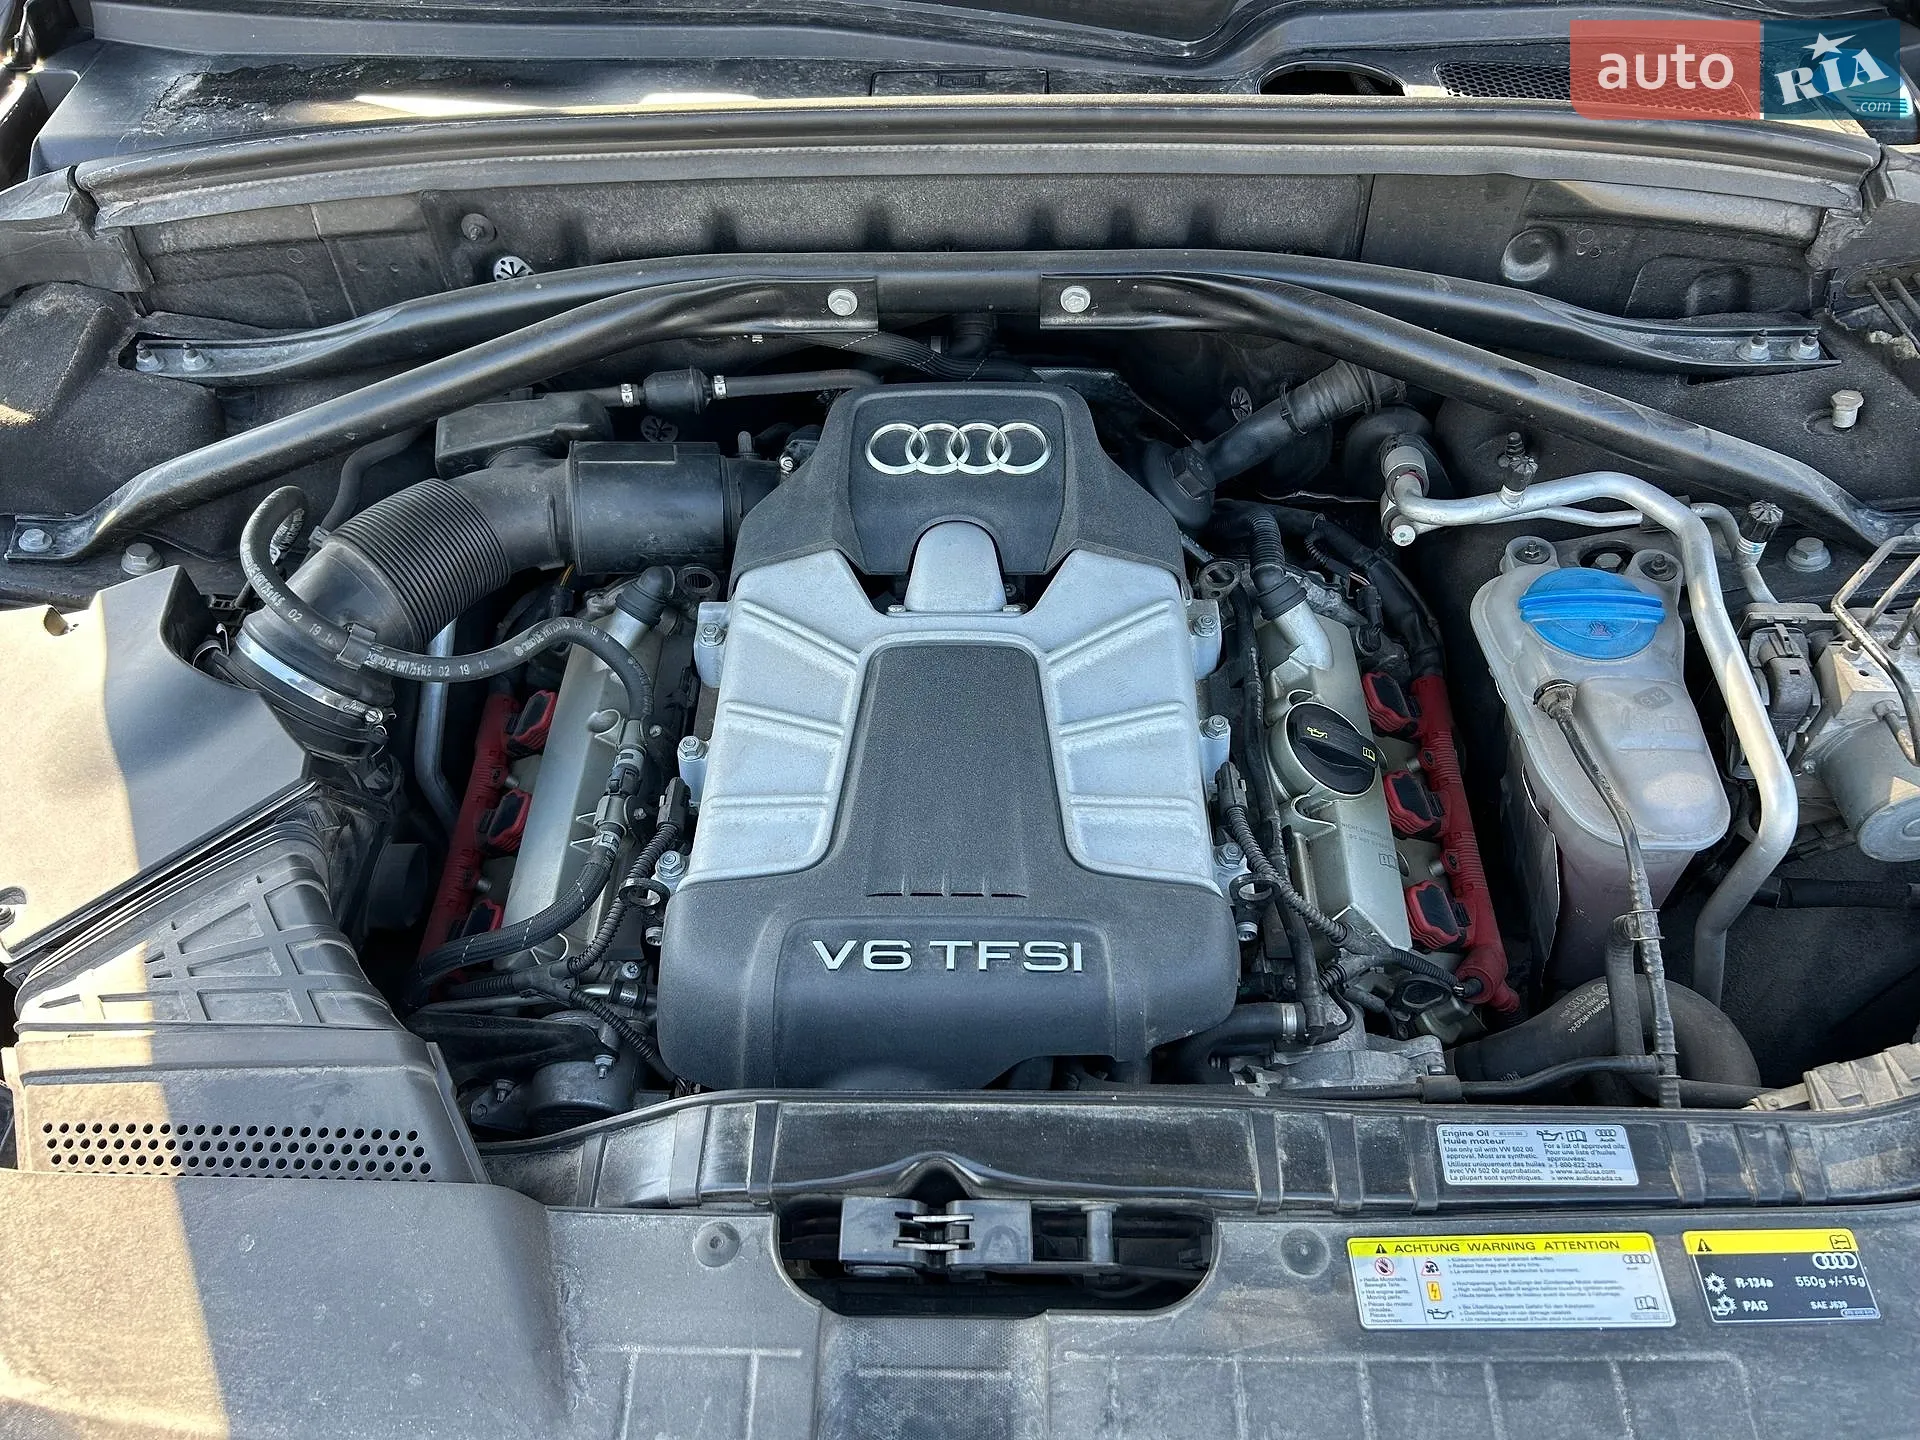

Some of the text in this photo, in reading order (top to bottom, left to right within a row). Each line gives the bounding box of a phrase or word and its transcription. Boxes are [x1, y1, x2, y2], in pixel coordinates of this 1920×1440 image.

[812, 940, 1083, 973] V6 TFSI
[1442, 1129, 1474, 1138] Engine
[1476, 1129, 1490, 1137] Oil
[1394, 1240, 1620, 1253] ACHTUNG WARNING ATTENTION
[1735, 1275, 1866, 1289] R-134a 550g +/-15g
[1742, 1300, 1769, 1312] PAG
[1810, 1302, 1828, 1310] SAE
